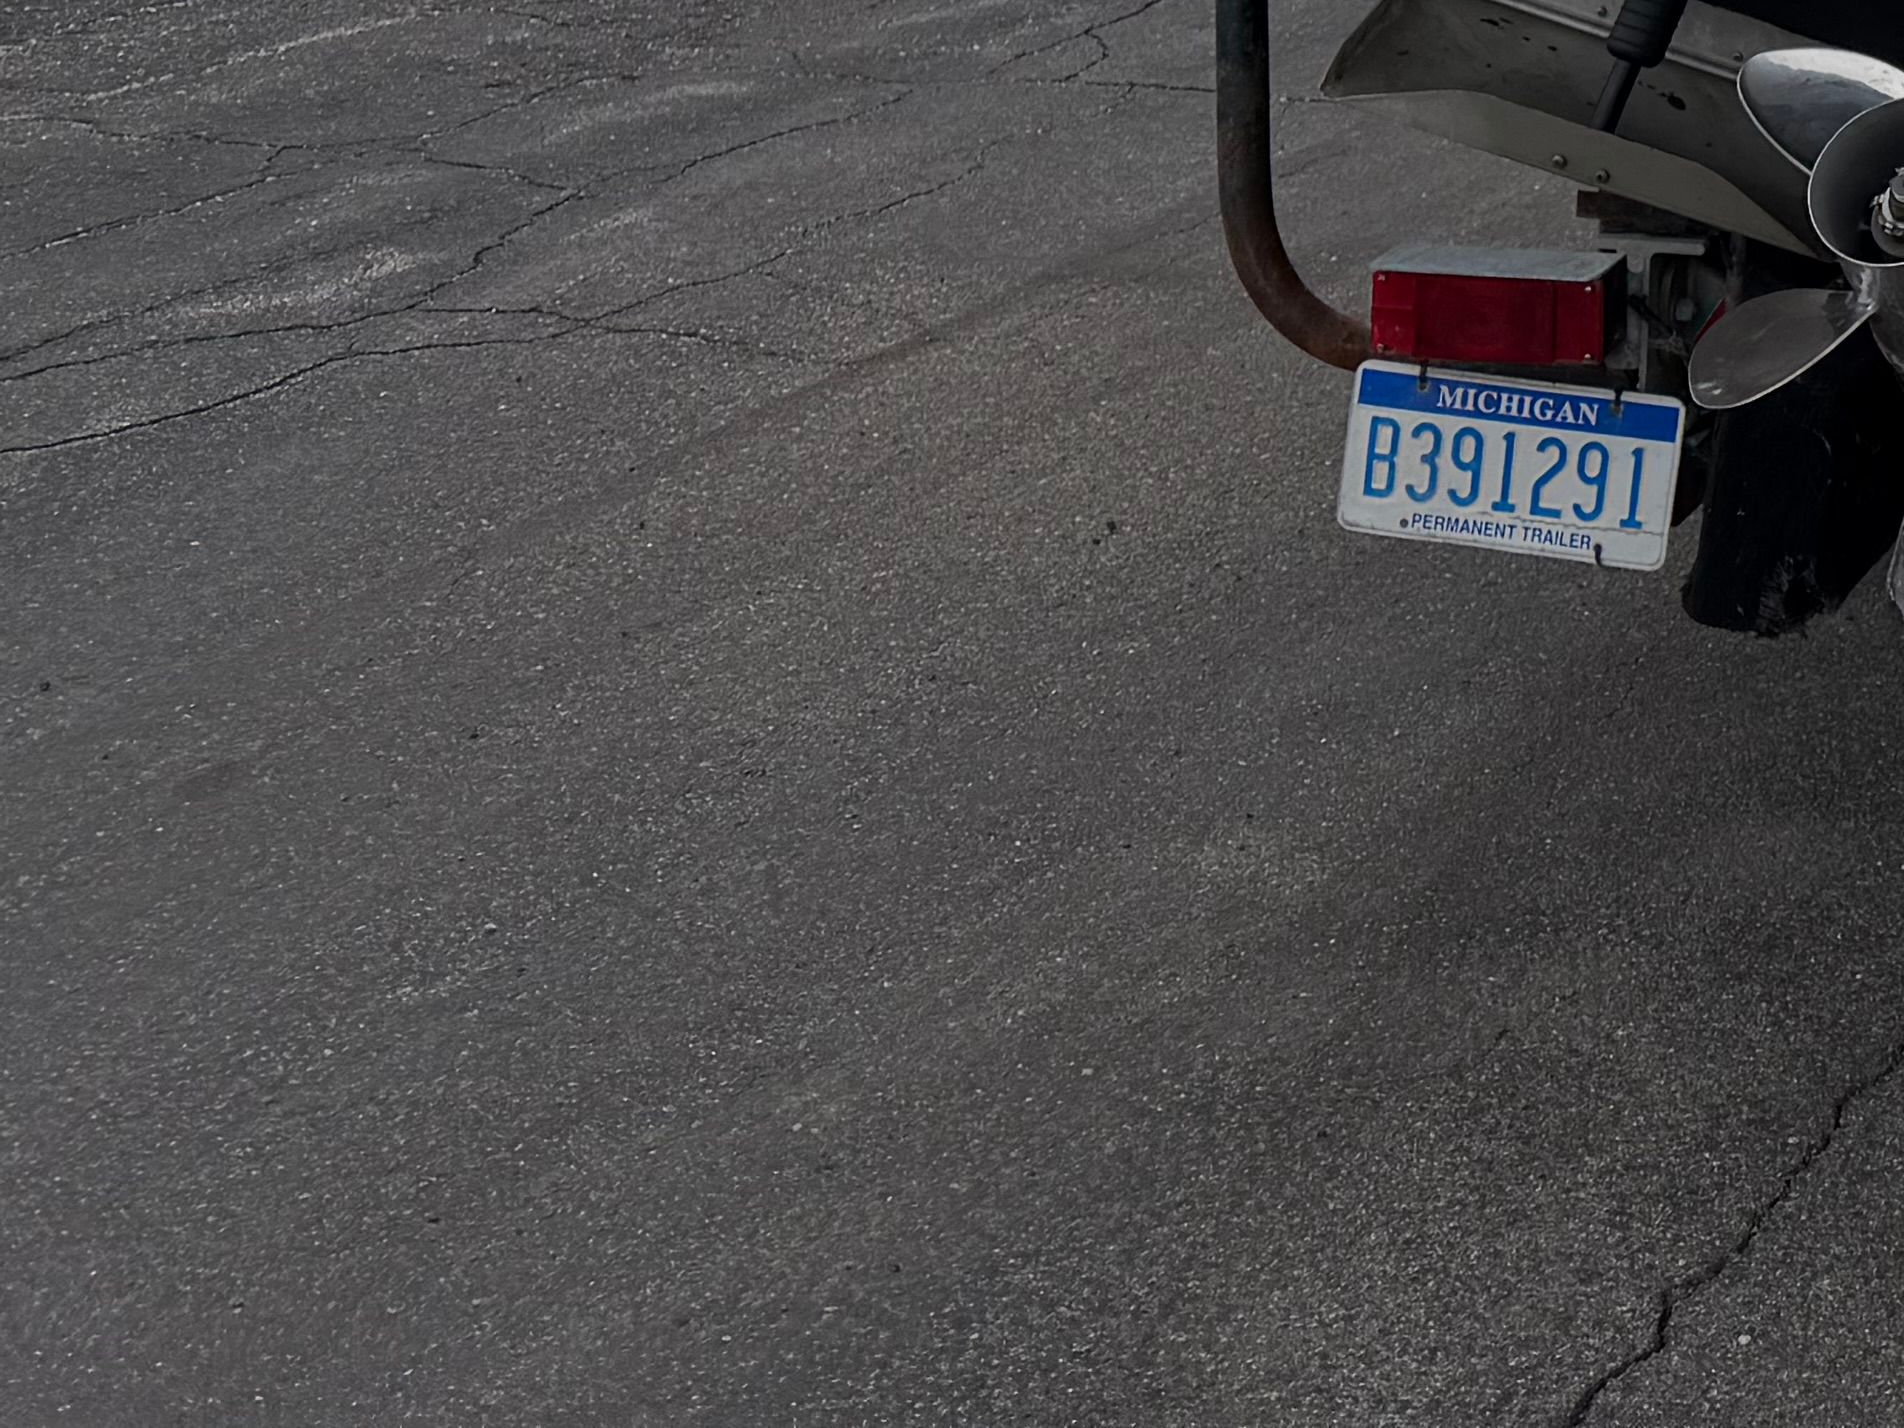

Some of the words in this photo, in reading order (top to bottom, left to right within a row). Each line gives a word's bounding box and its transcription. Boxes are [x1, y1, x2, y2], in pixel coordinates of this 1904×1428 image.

[1436, 384, 1599, 426] MICHIGAN
[1362, 415, 1646, 531] B391291
[1411, 512, 1517, 540] PERMANENT
[1522, 525, 1592, 550] TRAILER
